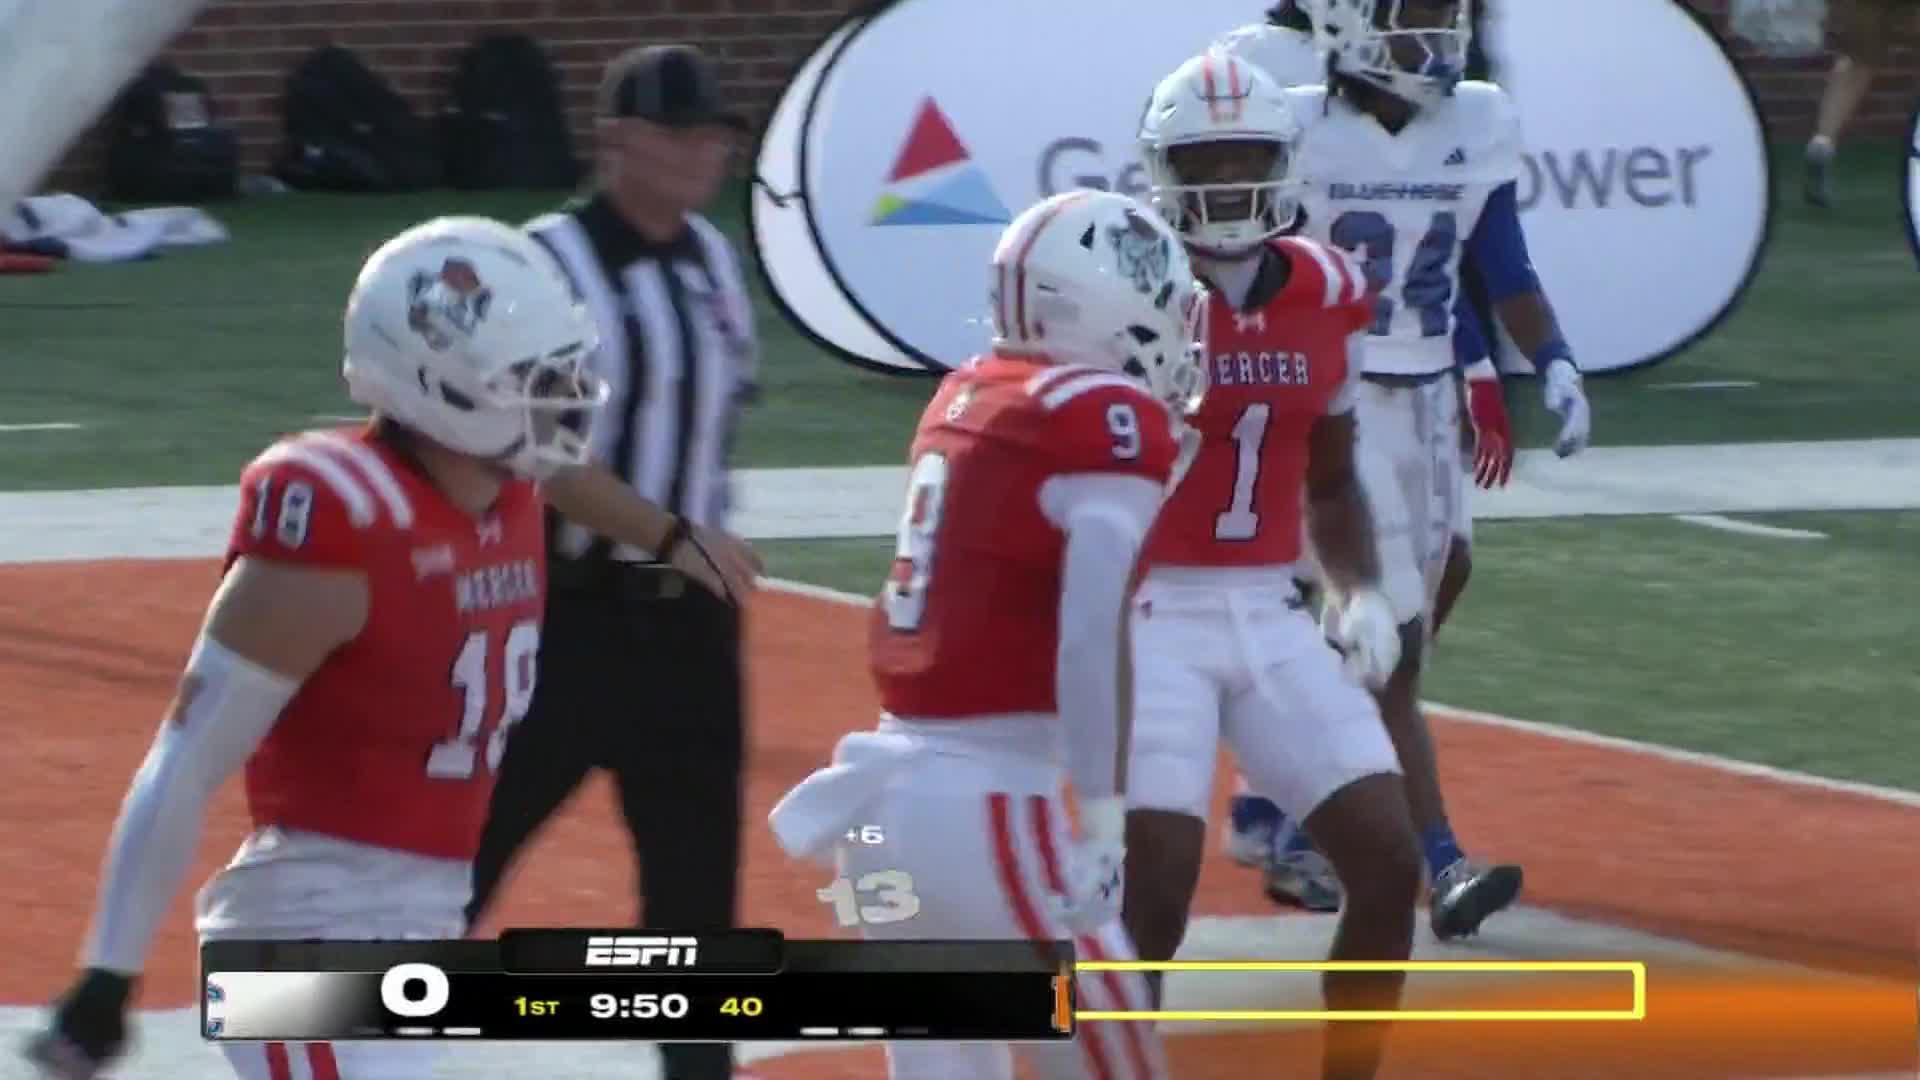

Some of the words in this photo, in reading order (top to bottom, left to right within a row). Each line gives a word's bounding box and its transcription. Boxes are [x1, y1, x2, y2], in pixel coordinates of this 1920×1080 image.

[1519, 145, 1713, 211] ower
[1204, 350, 1311, 386] ERCER
[1105, 402, 1142, 461] 9
[1214, 401, 1271, 542] 1
[249, 474, 315, 550] 18
